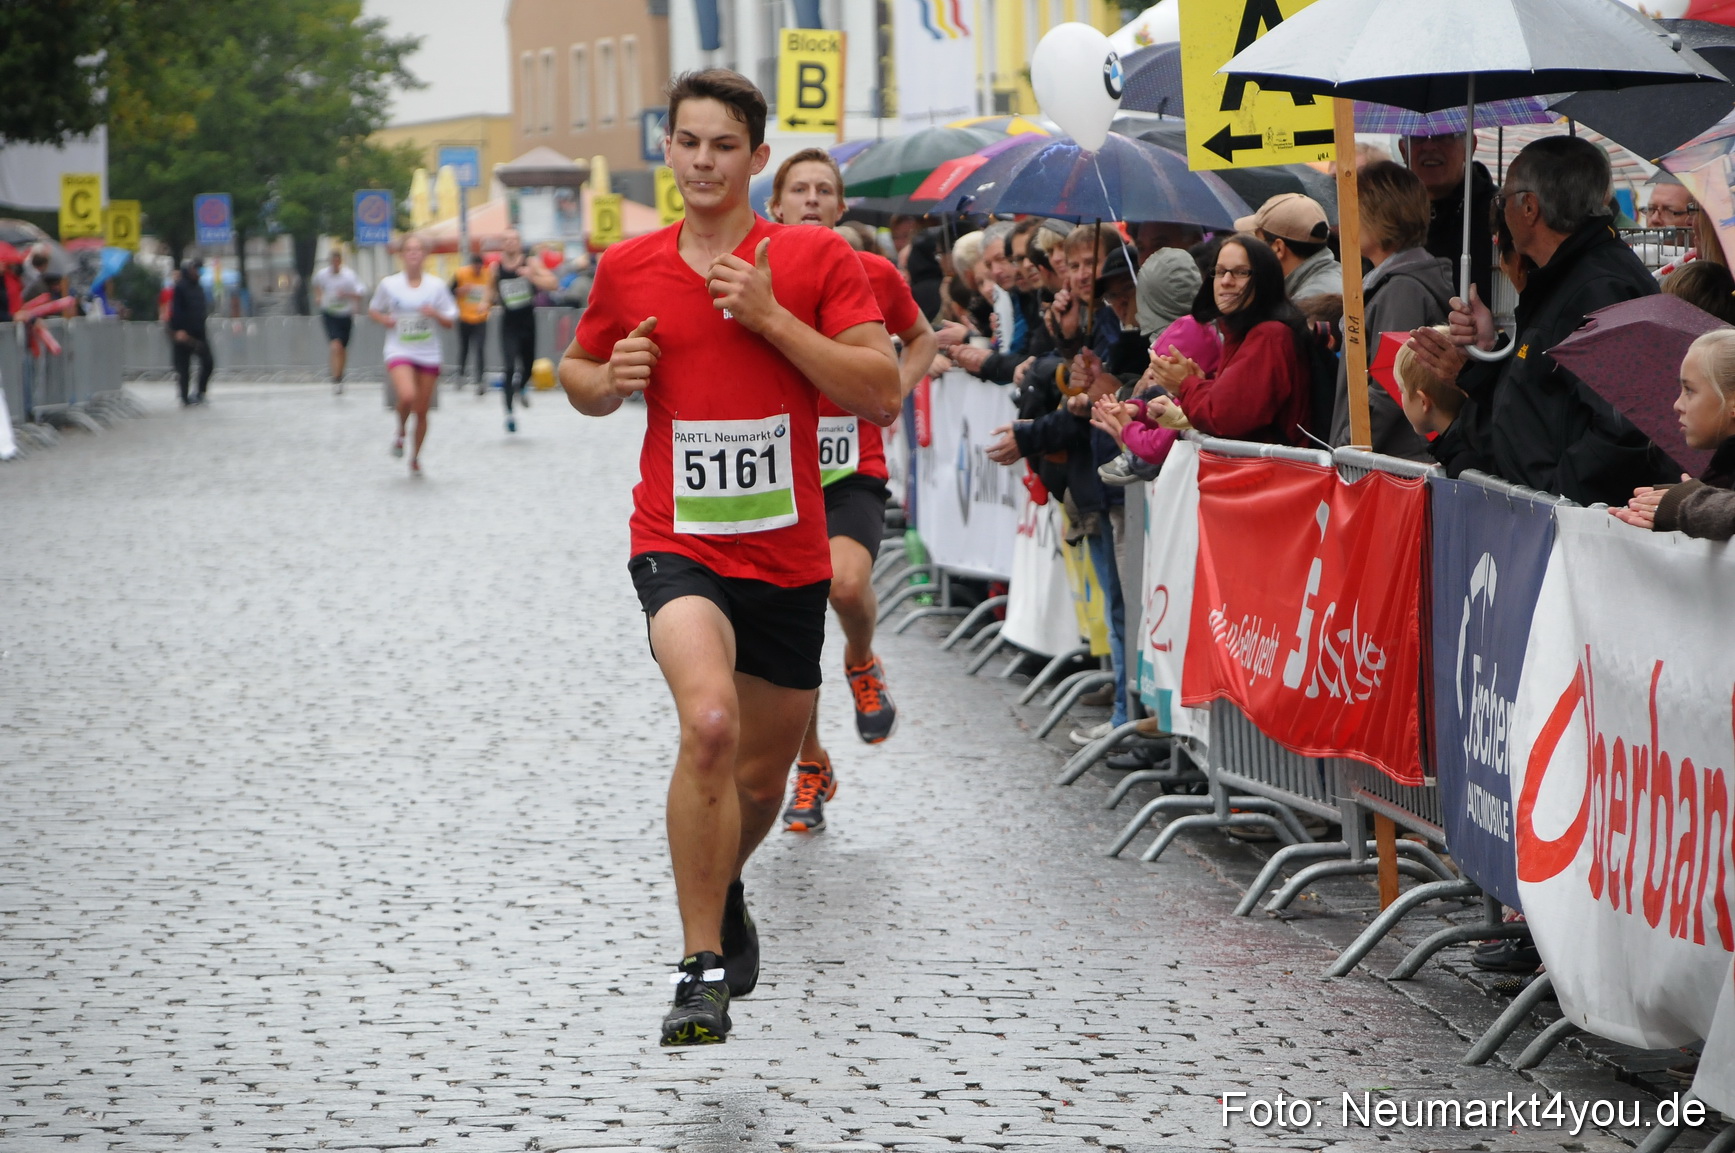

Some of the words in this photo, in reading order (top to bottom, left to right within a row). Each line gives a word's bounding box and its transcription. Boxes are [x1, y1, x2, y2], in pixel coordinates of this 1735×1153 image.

[787, 33, 839, 52] Block
[797, 62, 828, 109] B
[69, 189, 92, 219] C
[674, 432, 712, 443] PARTL
[715, 430, 771, 443] Neumarkt
[819, 436, 850, 465] 60
[684, 444, 777, 490] 5161
[1237, 614, 1263, 670] Geld
[1249, 623, 1281, 687] geht
[1467, 653, 1516, 776] Fscher
[1466, 780, 1510, 843] AUTOMOBILE
